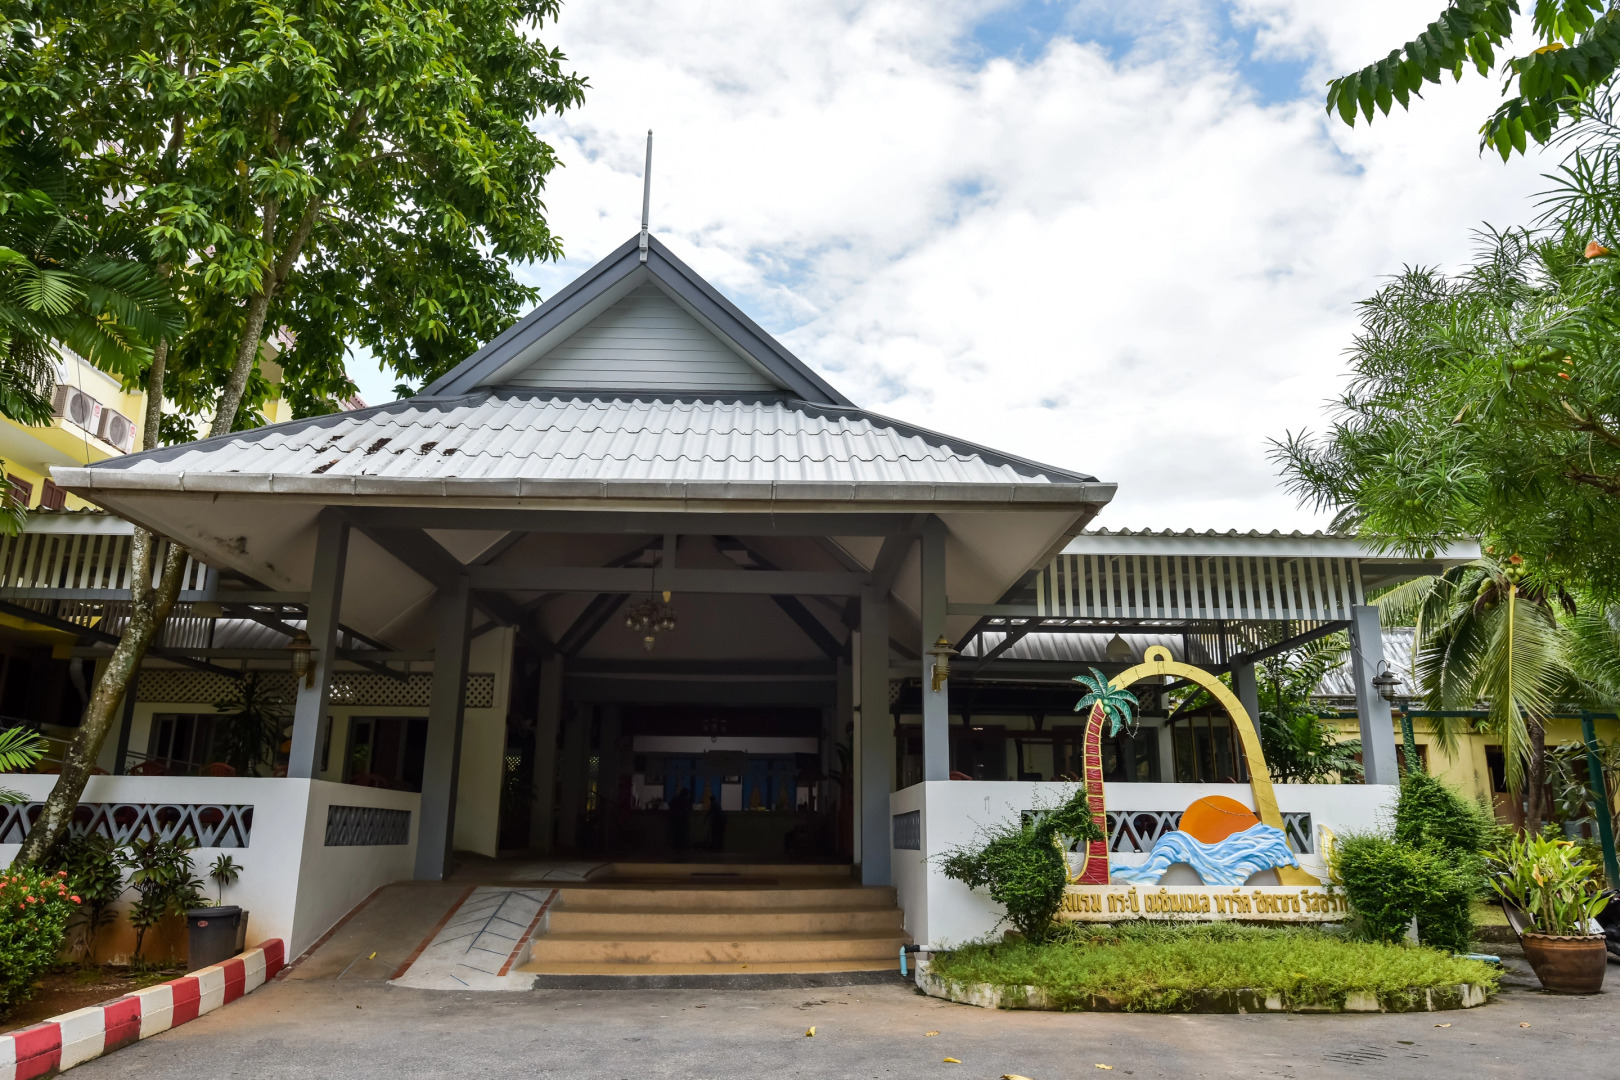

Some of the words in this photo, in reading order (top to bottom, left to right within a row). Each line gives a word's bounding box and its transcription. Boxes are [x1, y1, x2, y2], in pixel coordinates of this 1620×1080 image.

[1107, 886, 1139, 913] กระบี่
[1213, 888, 1251, 913] พาร์ค
